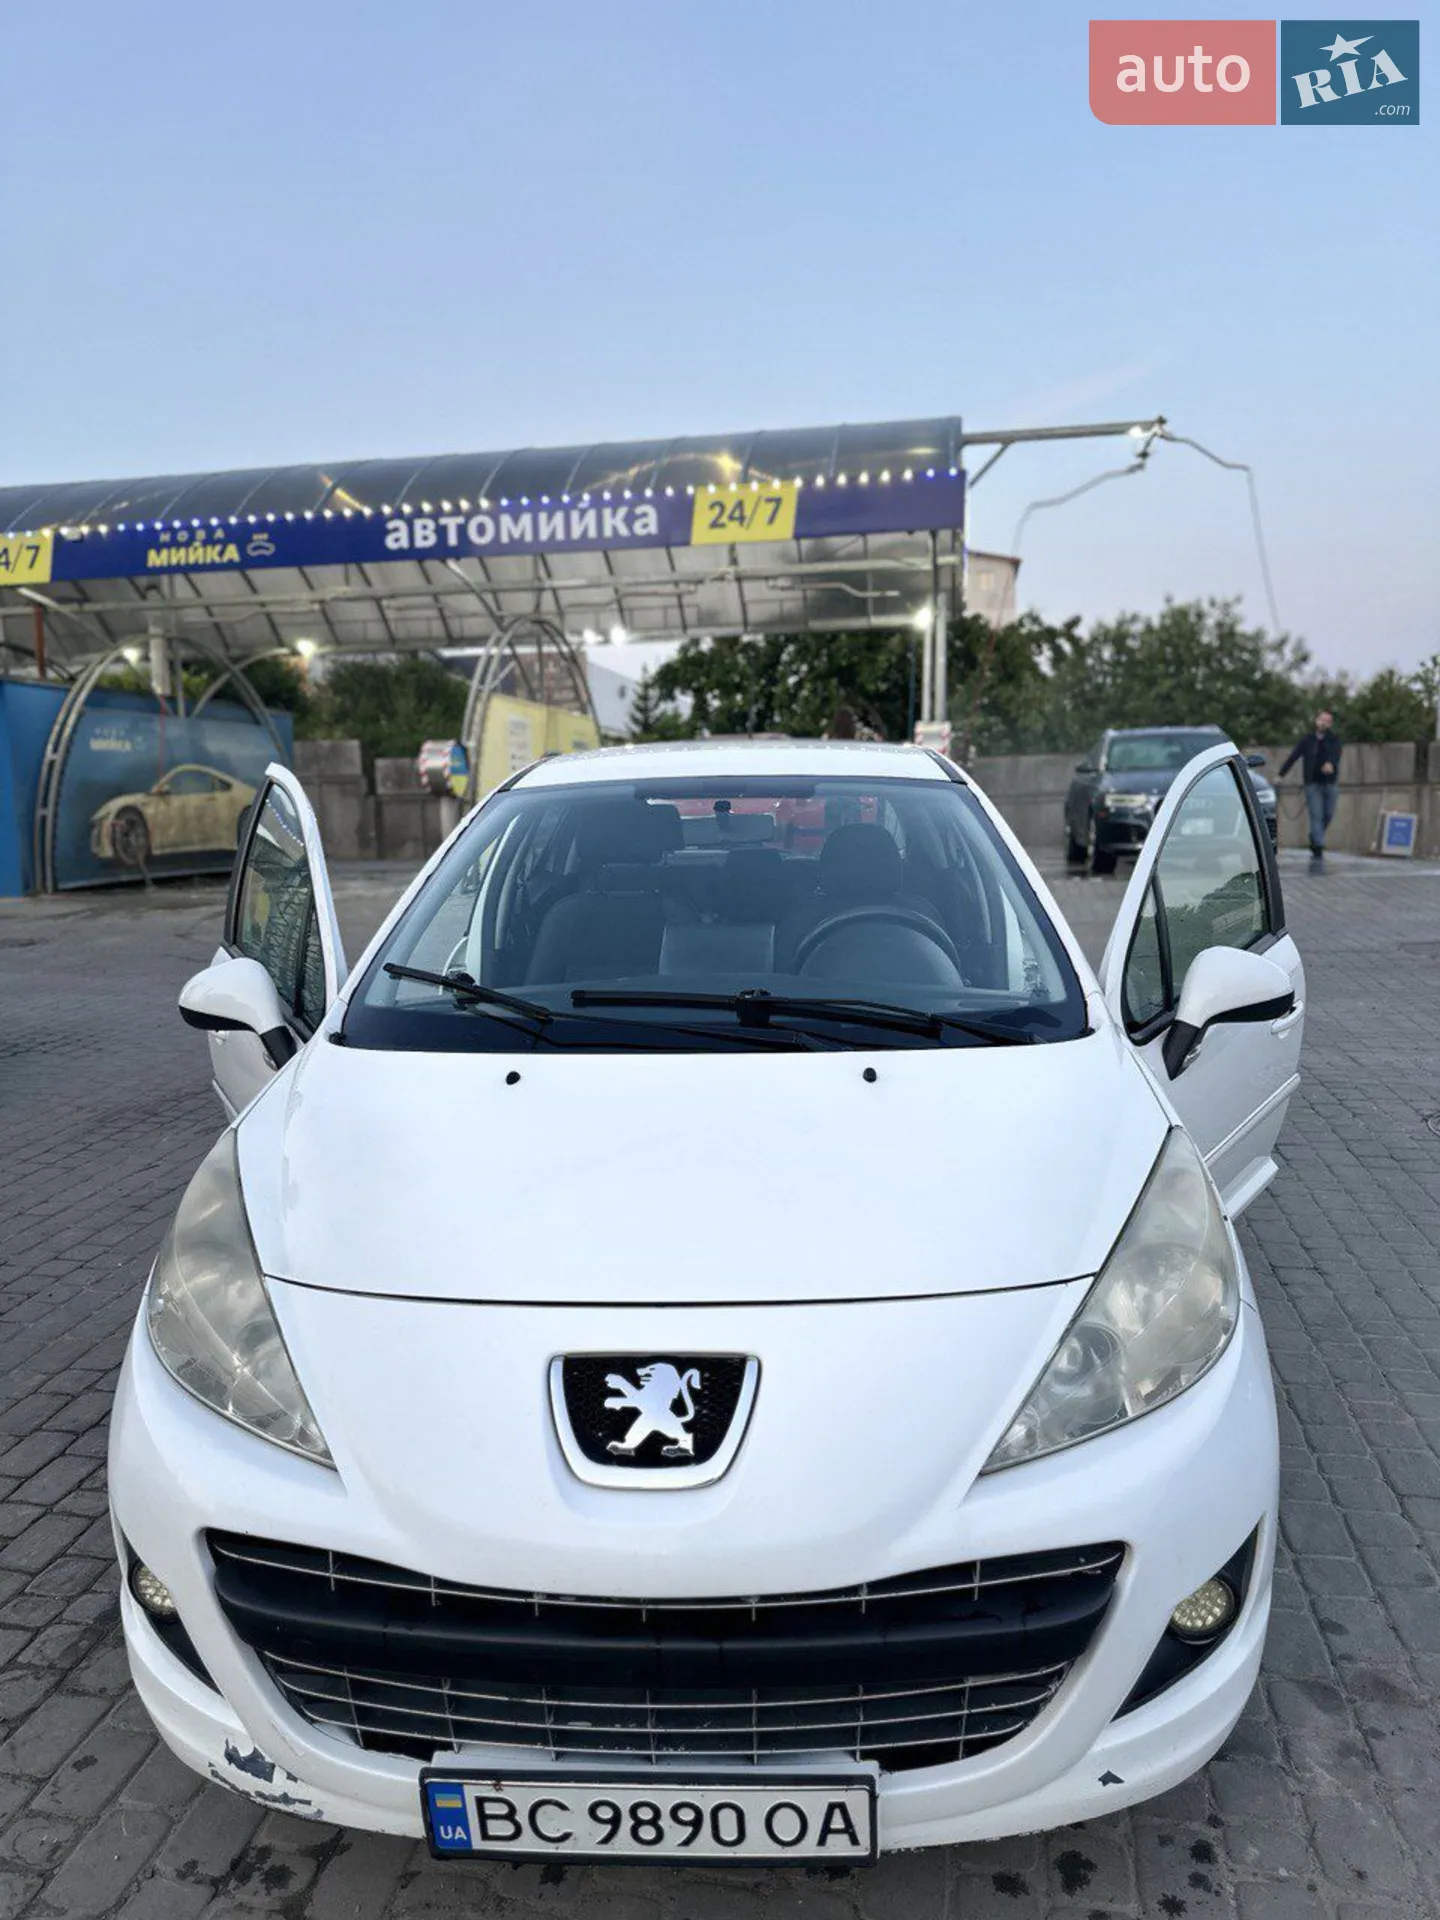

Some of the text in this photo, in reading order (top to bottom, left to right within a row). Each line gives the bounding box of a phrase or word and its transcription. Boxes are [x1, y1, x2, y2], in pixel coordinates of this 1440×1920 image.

[384, 502, 659, 550] автомийка
[708, 497, 783, 531] 24/7
[147, 542, 240, 567] МИЙКА
[440, 1825, 467, 1839] UA
[475, 1796, 860, 1847] BC 9890 OA
